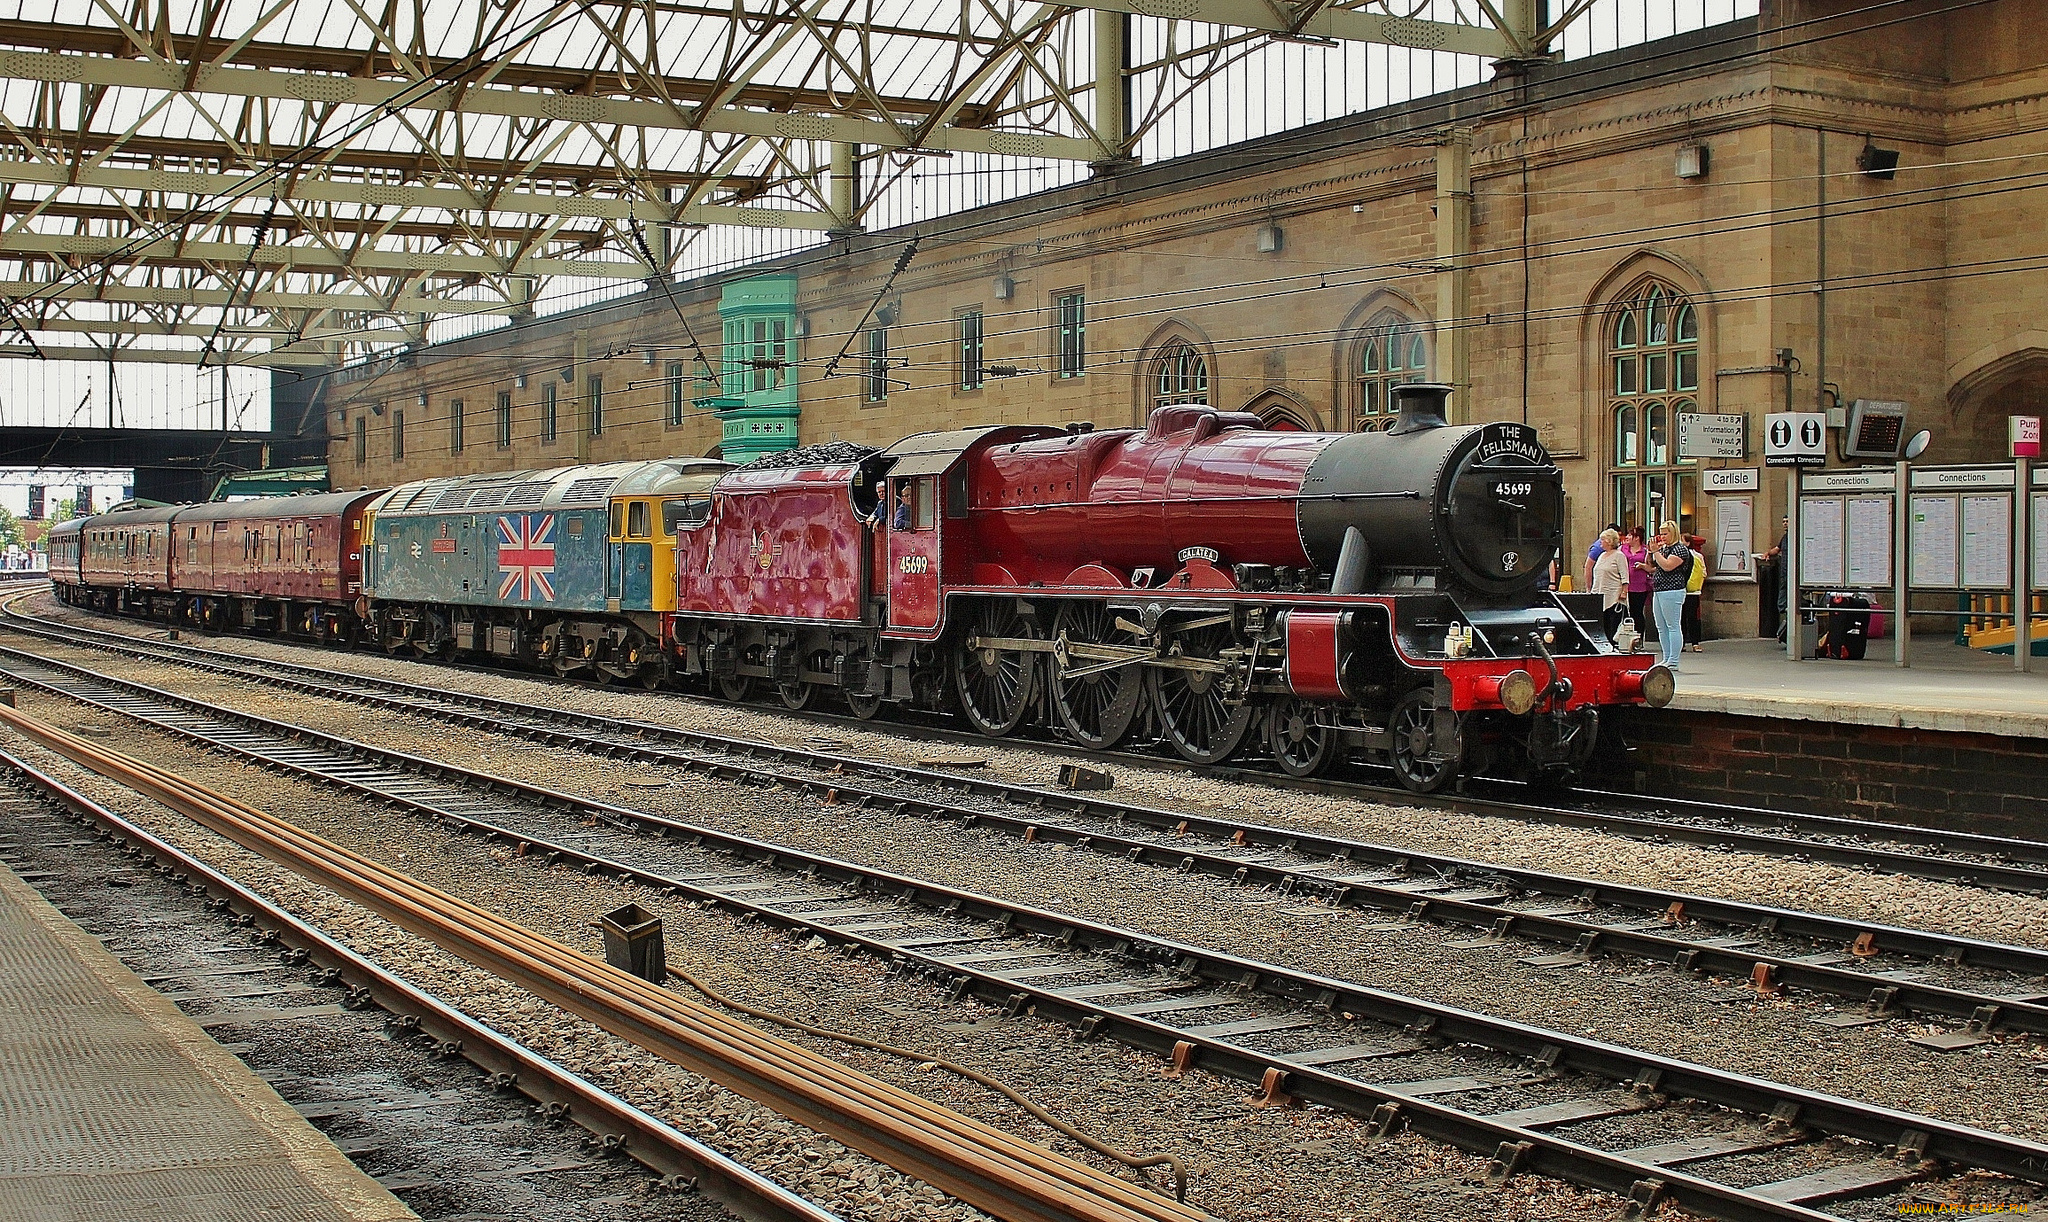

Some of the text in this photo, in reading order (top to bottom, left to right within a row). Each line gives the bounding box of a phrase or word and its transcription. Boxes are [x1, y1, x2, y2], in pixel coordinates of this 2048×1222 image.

[1499, 426, 1521, 438] THE
[1710, 437, 1724, 445] Way
[1482, 440, 1538, 459] FELLSMAN
[1712, 473, 1749, 484] Carlisle
[1826, 477, 1870, 485] Connections
[1938, 473, 1986, 482] Connections
[1495, 482, 1532, 495] 45699
[1182, 548, 1213, 559] GALATEA
[900, 556, 928, 574] 45699
